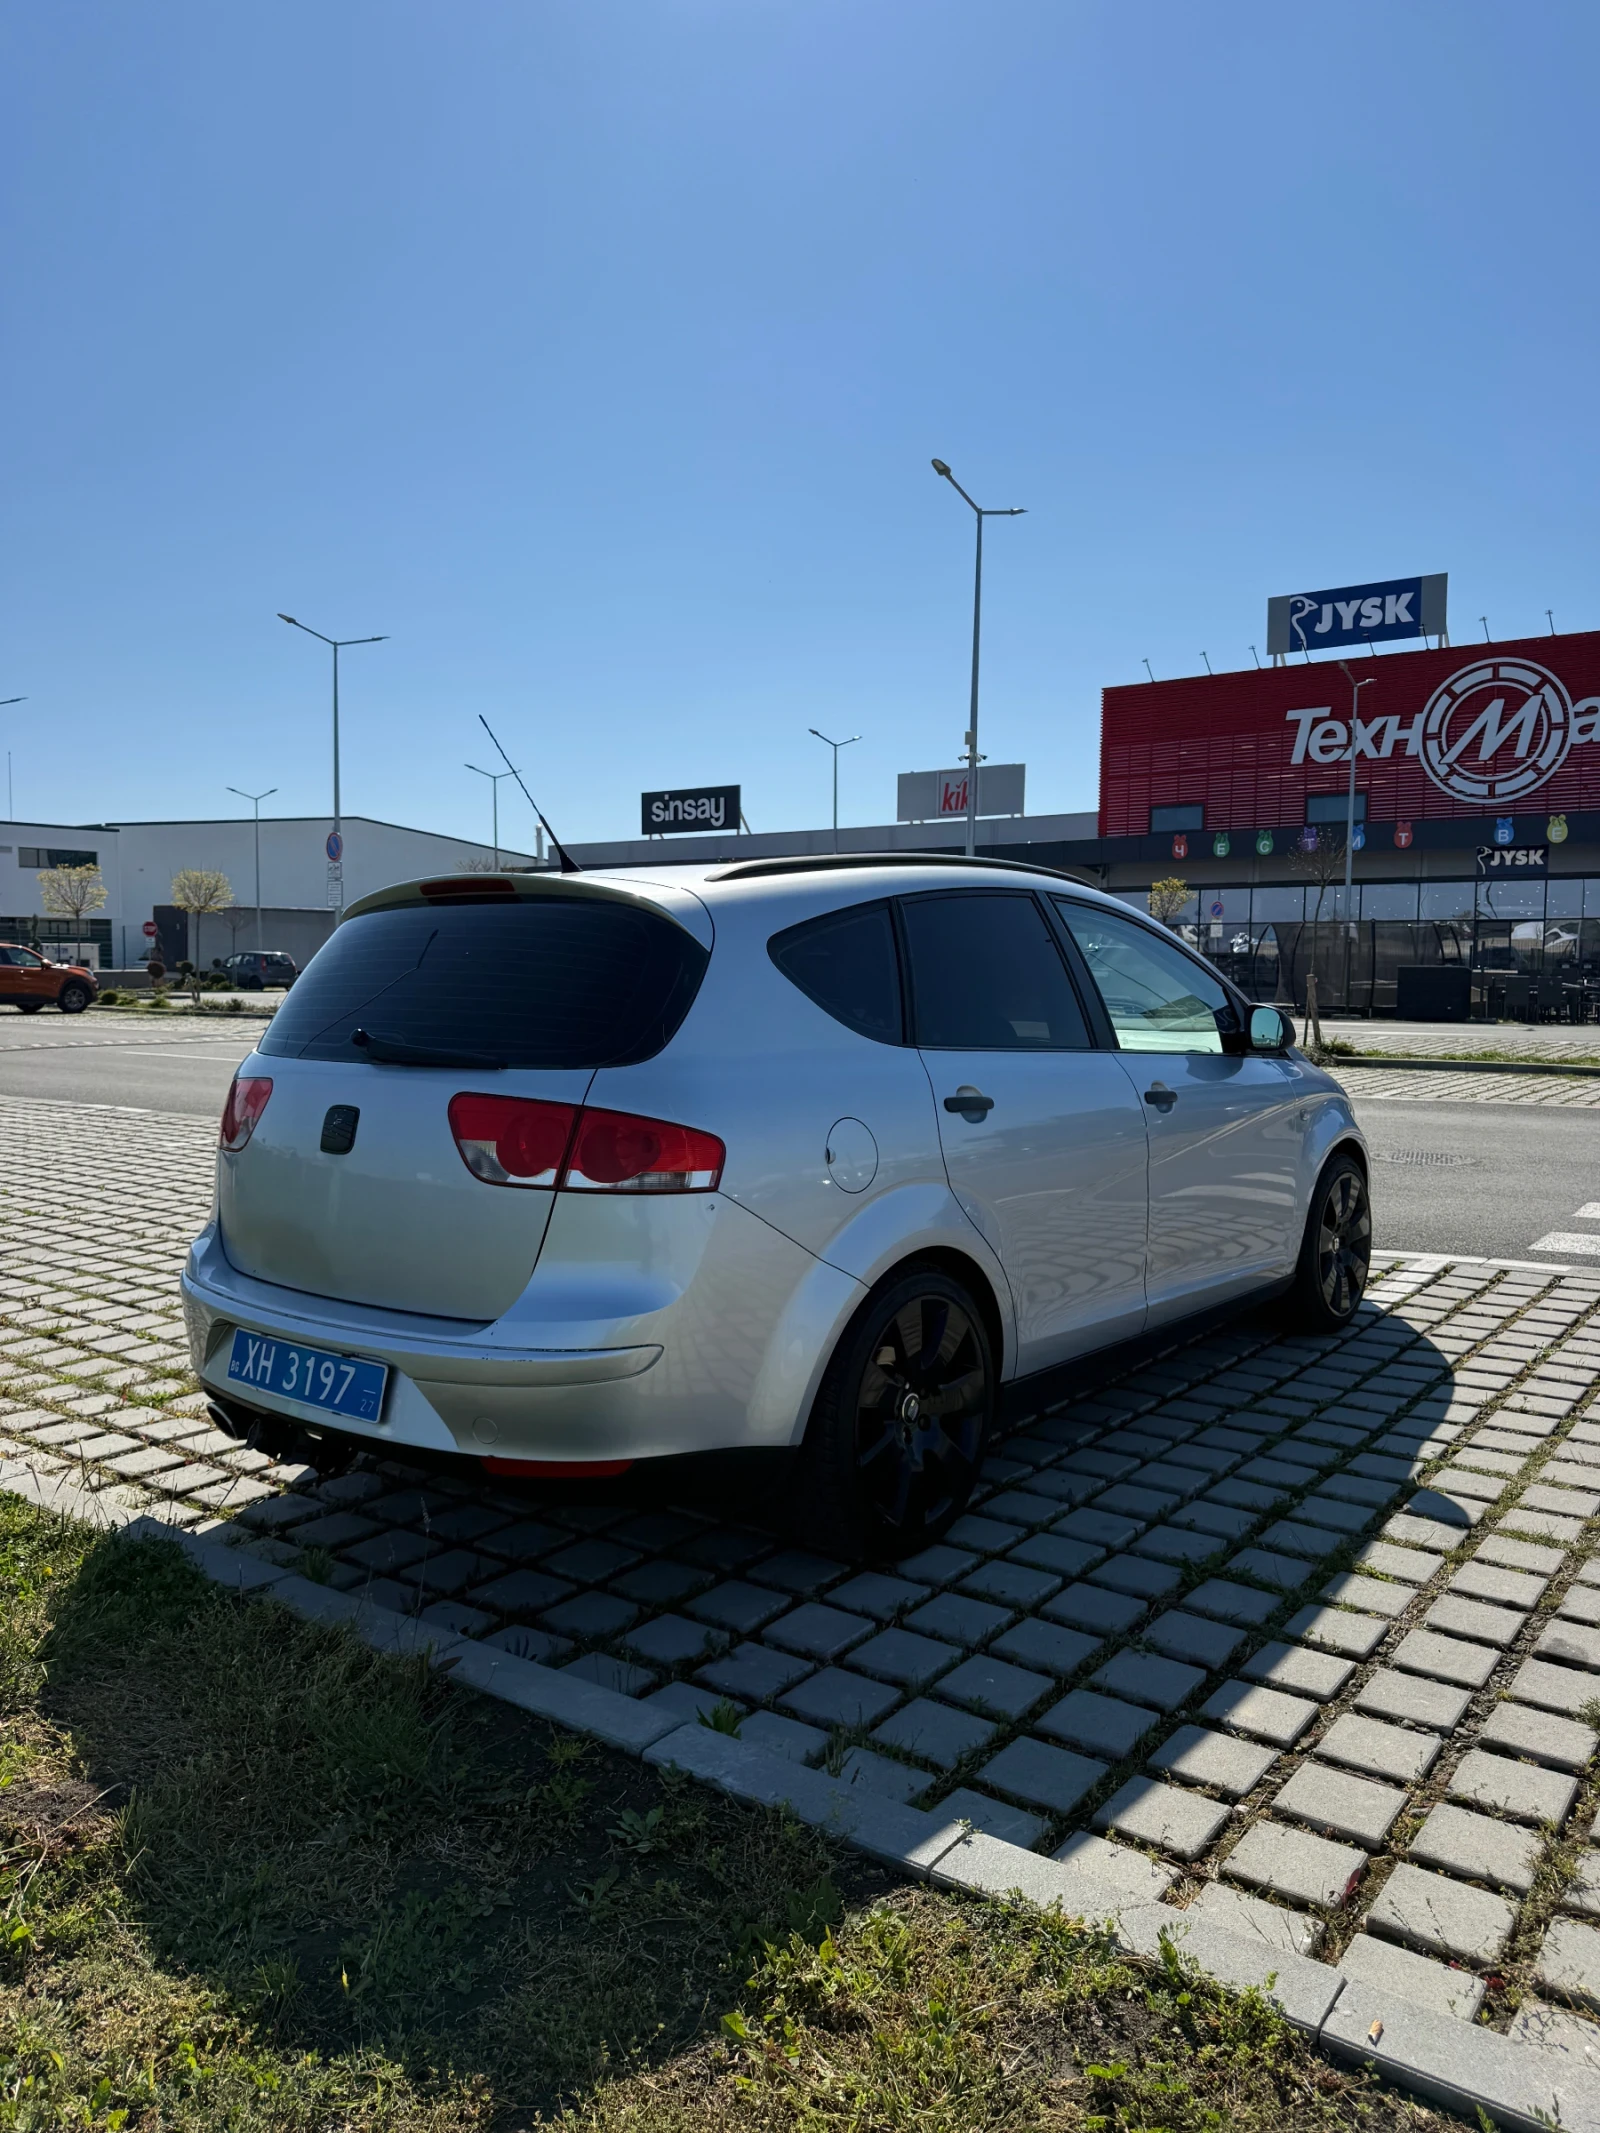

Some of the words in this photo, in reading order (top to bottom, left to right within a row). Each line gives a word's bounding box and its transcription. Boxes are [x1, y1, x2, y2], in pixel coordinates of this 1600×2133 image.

[1314, 592, 1415, 634] JYSK
[651, 794, 725, 827] sinsay
[1490, 849, 1544, 866] JYSK
[230, 1360, 240, 1373] BG
[242, 1339, 275, 1384] XH
[282, 1352, 356, 1404] 3197
[360, 1399, 375, 1413] 27
